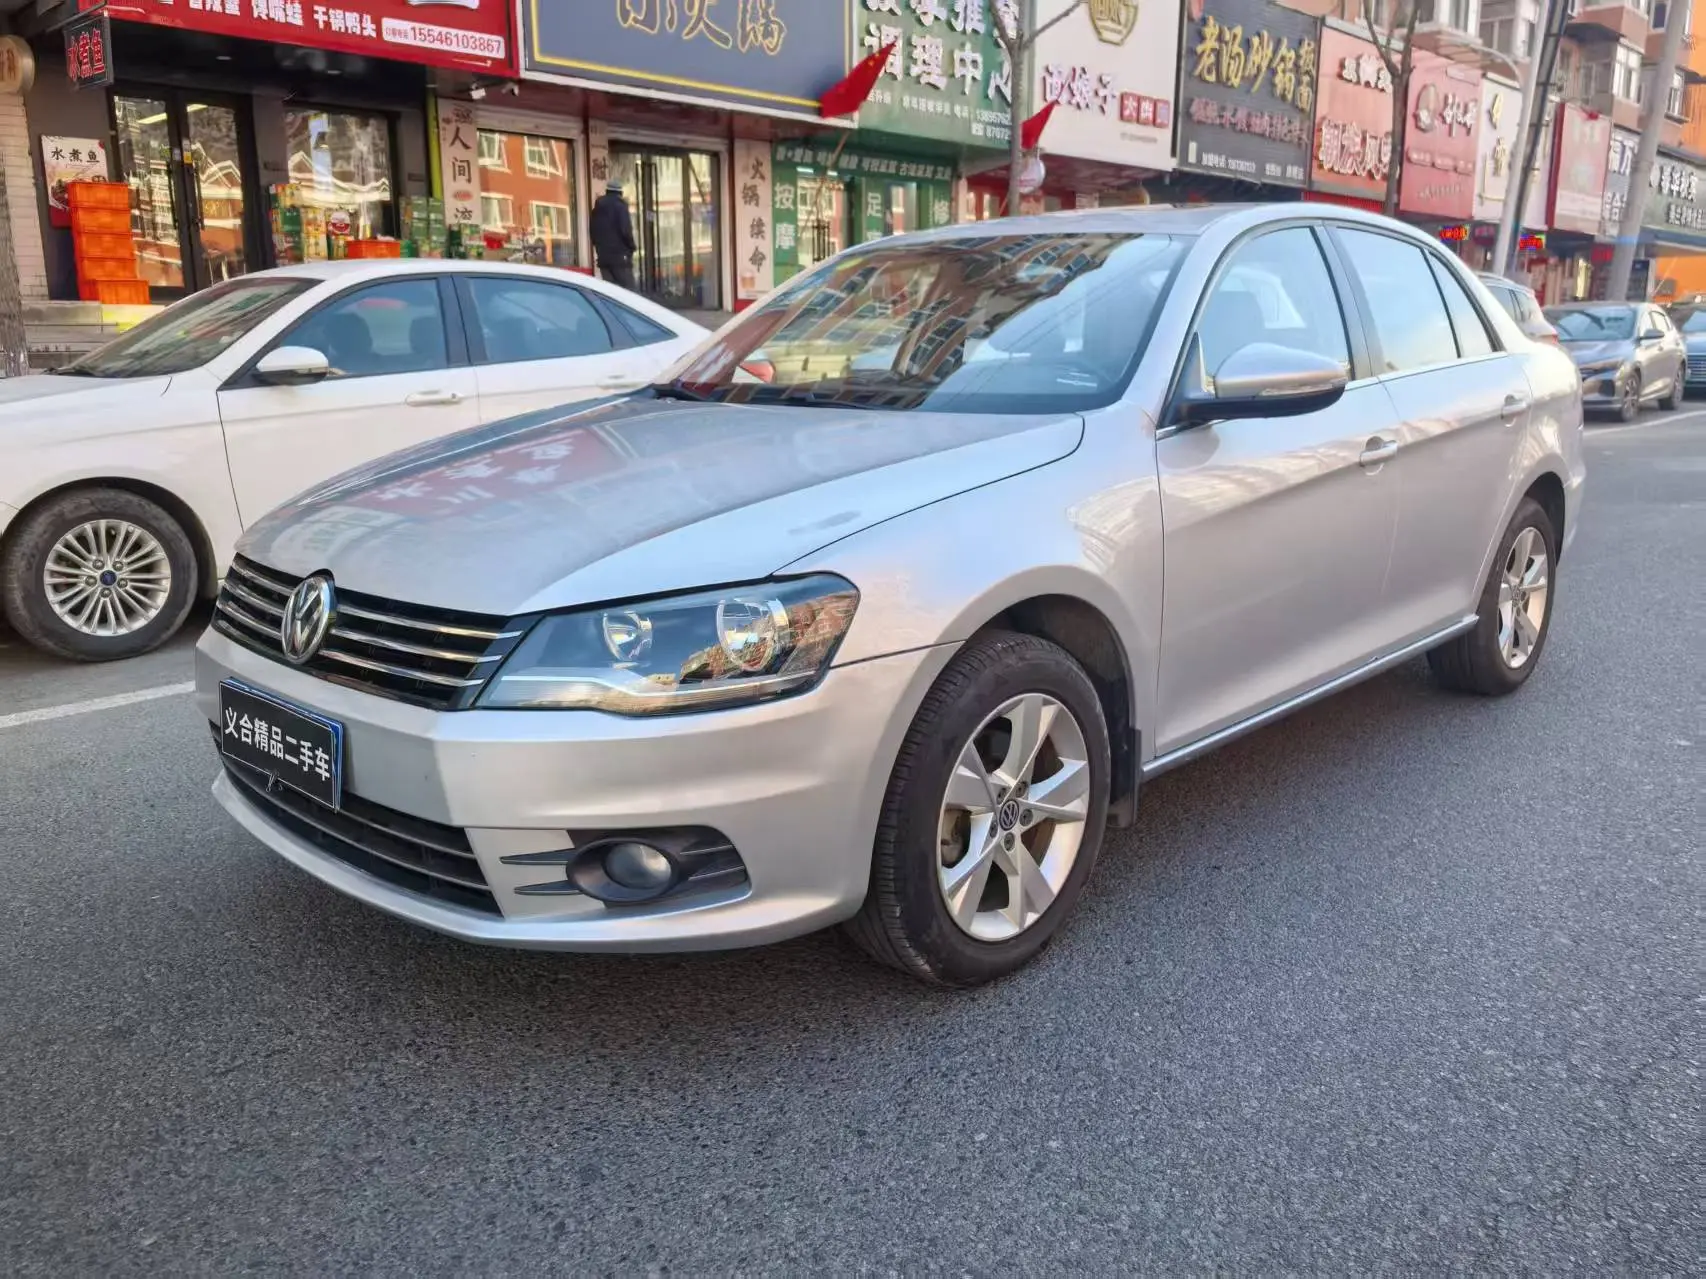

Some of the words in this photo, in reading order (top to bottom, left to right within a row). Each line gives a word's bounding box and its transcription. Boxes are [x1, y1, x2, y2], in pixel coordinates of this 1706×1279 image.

[313, 4, 377, 38] 干锅鸭头
[410, 26, 502, 54] 15546103867
[67, 28, 105, 82] 水煮鱼
[51, 147, 100, 163] 水煮鱼
[742, 155, 767, 273] 火锅续命
[774, 182, 796, 250] 按摩
[224, 706, 331, 781] 义合精品二手车
